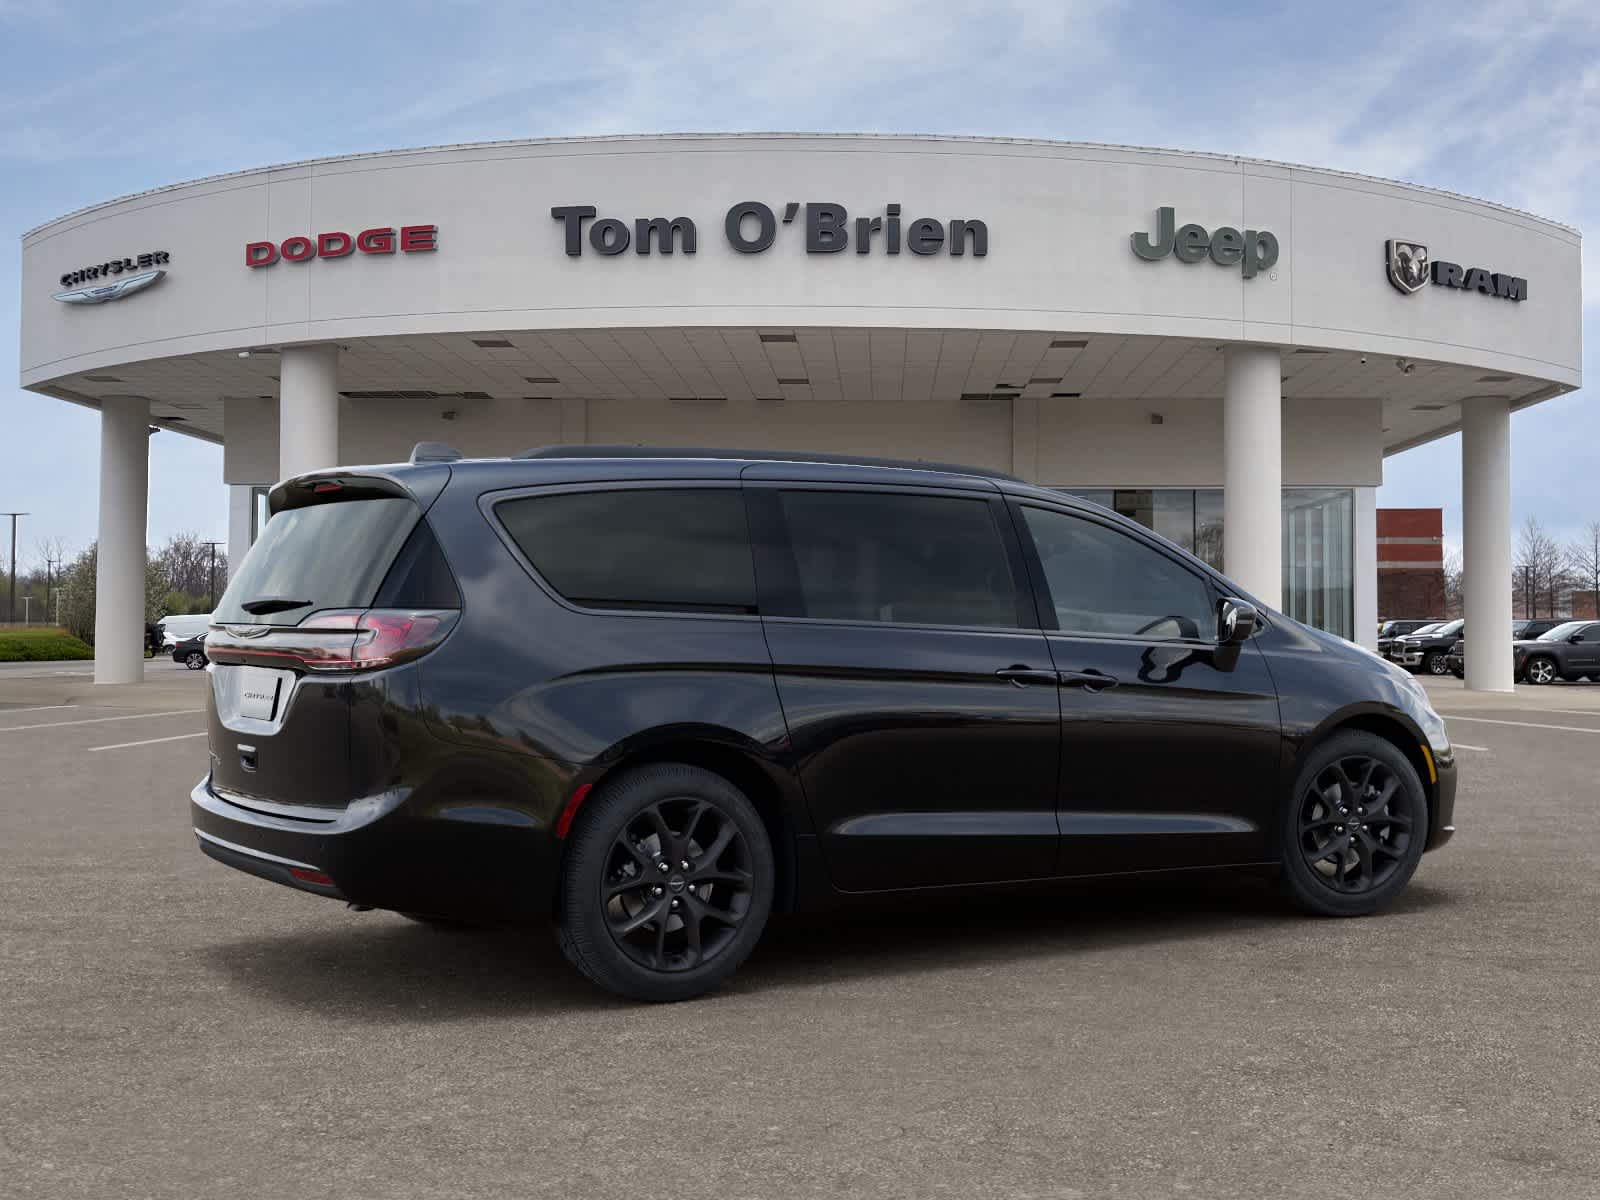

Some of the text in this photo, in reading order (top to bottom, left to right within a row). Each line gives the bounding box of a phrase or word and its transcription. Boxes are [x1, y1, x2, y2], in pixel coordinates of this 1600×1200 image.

[245, 225, 438, 268] DODGE
[551, 201, 988, 256] Tom O'Brien
[1130, 206, 1279, 279] Jeep
[60, 250, 170, 287] CHRYSLER
[1431, 260, 1527, 302] RAM
